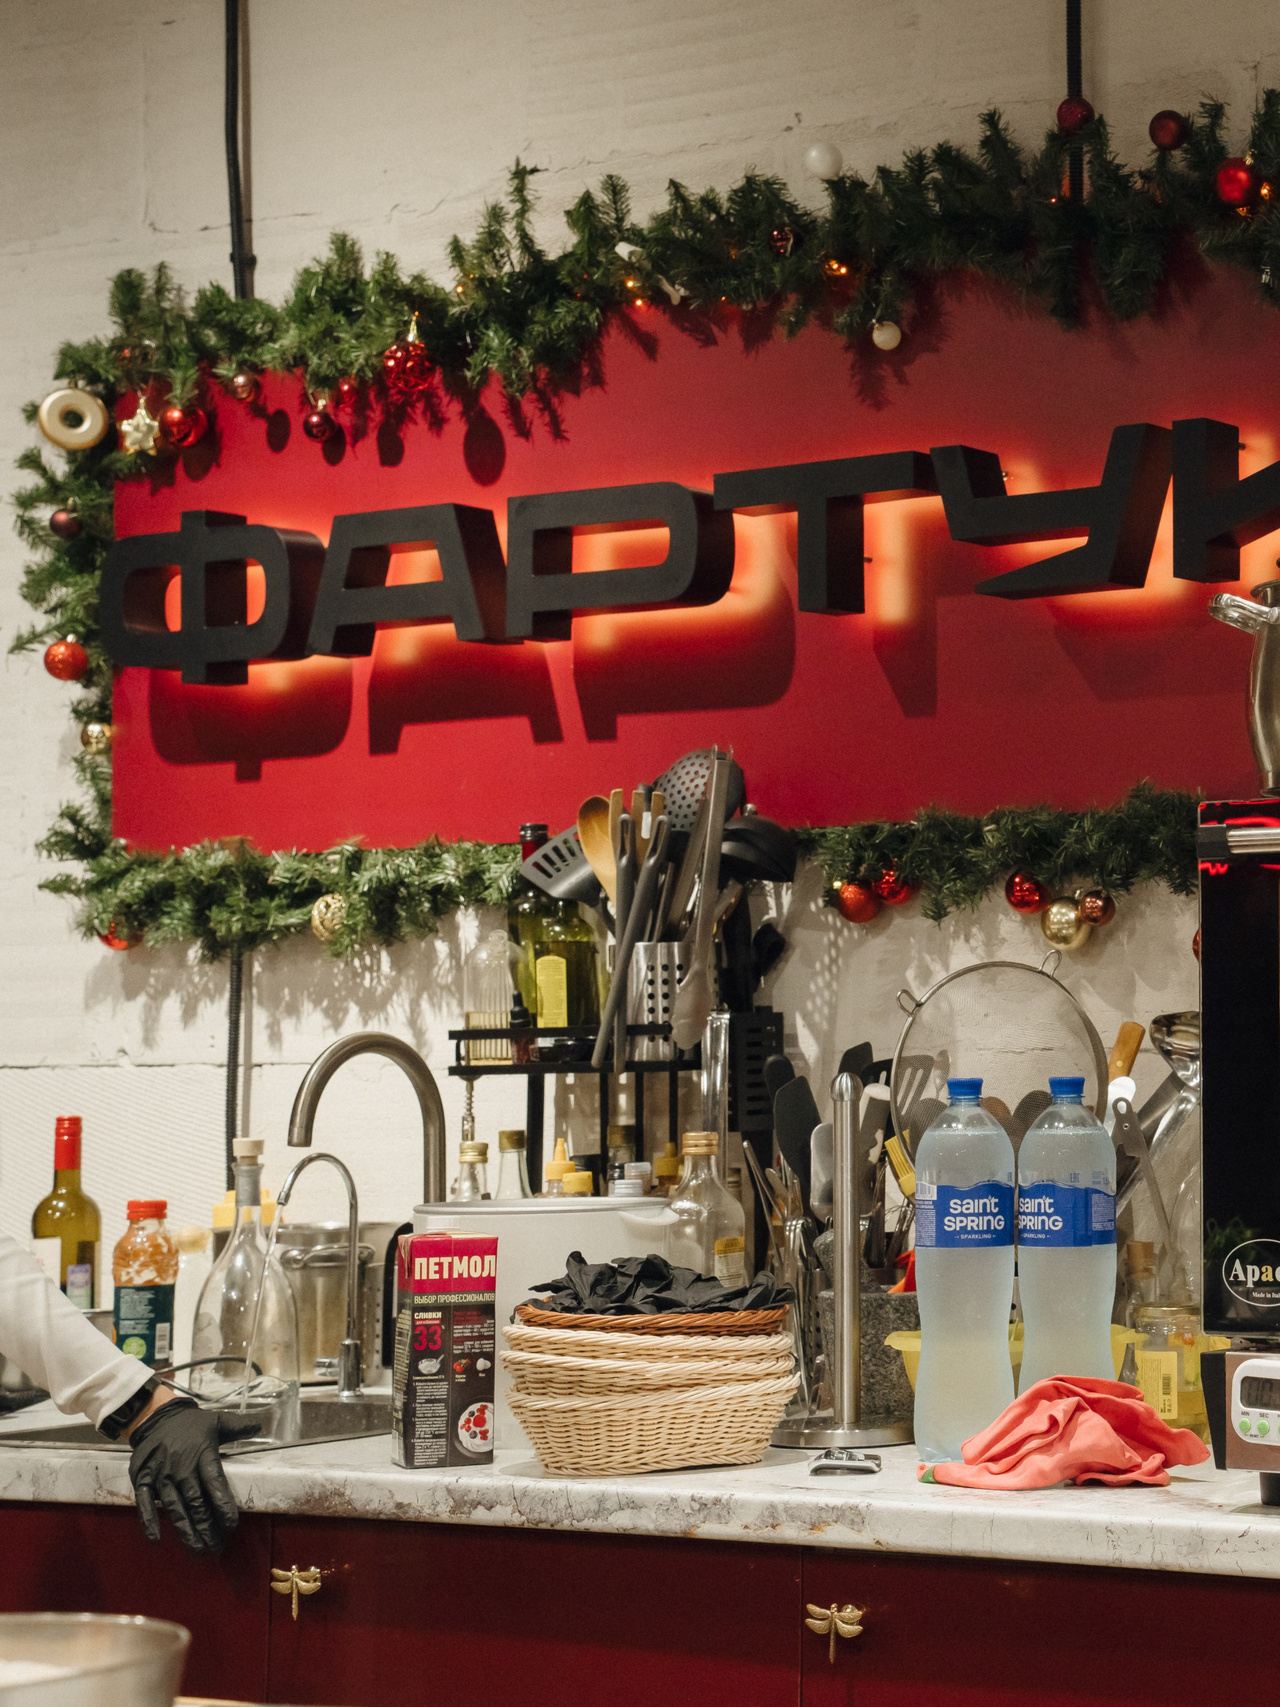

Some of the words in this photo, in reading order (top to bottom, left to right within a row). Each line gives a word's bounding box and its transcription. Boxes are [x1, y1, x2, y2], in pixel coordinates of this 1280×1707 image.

[949, 1196, 999, 1214] saint
[943, 1214, 1005, 1231] SPRING
[414, 1254, 496, 1280] ПЕТМОЛ
[414, 1295, 437, 1305] ВЫБОР
[437, 1292, 495, 1303] ПРОФЕССИОНАЛОВ
[413, 1326, 442, 1351] 33
